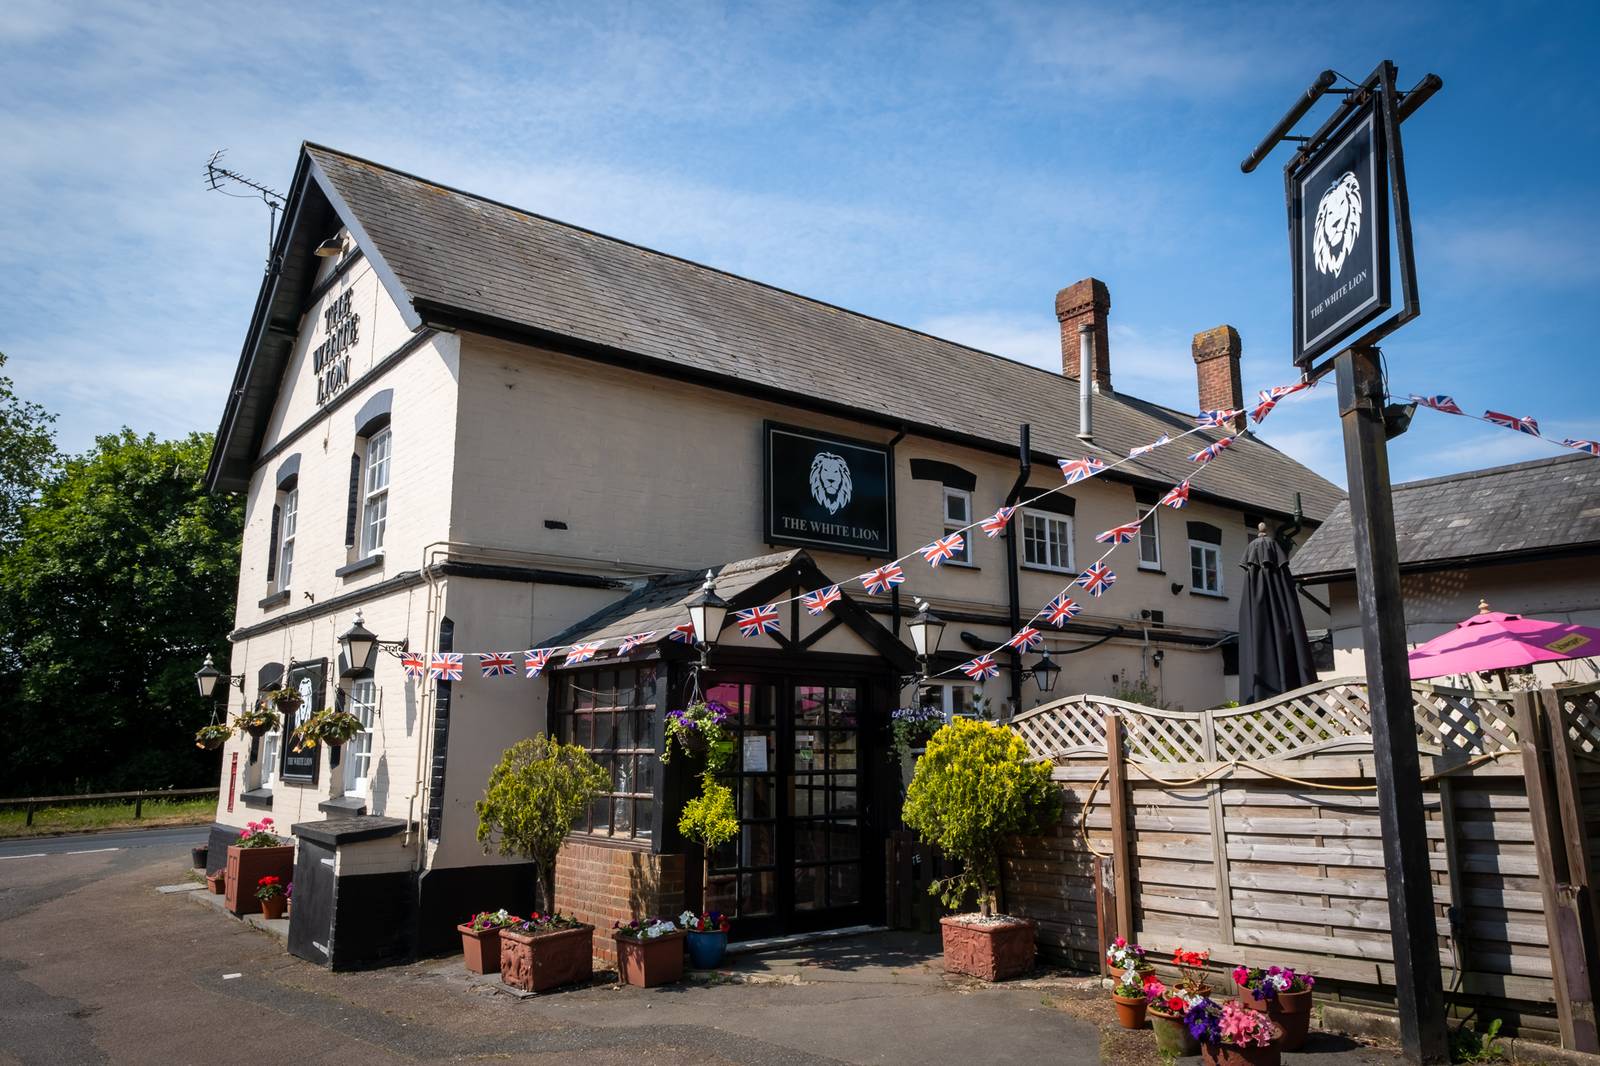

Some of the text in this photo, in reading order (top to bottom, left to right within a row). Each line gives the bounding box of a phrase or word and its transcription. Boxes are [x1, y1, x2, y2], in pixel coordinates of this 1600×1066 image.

[325, 287, 354, 335] THE
[1310, 269, 1367, 319] THE WHITE LION
[313, 313, 360, 375] WHITE
[316, 355, 351, 406] LION
[782, 516, 879, 540] THE WHITE LION
